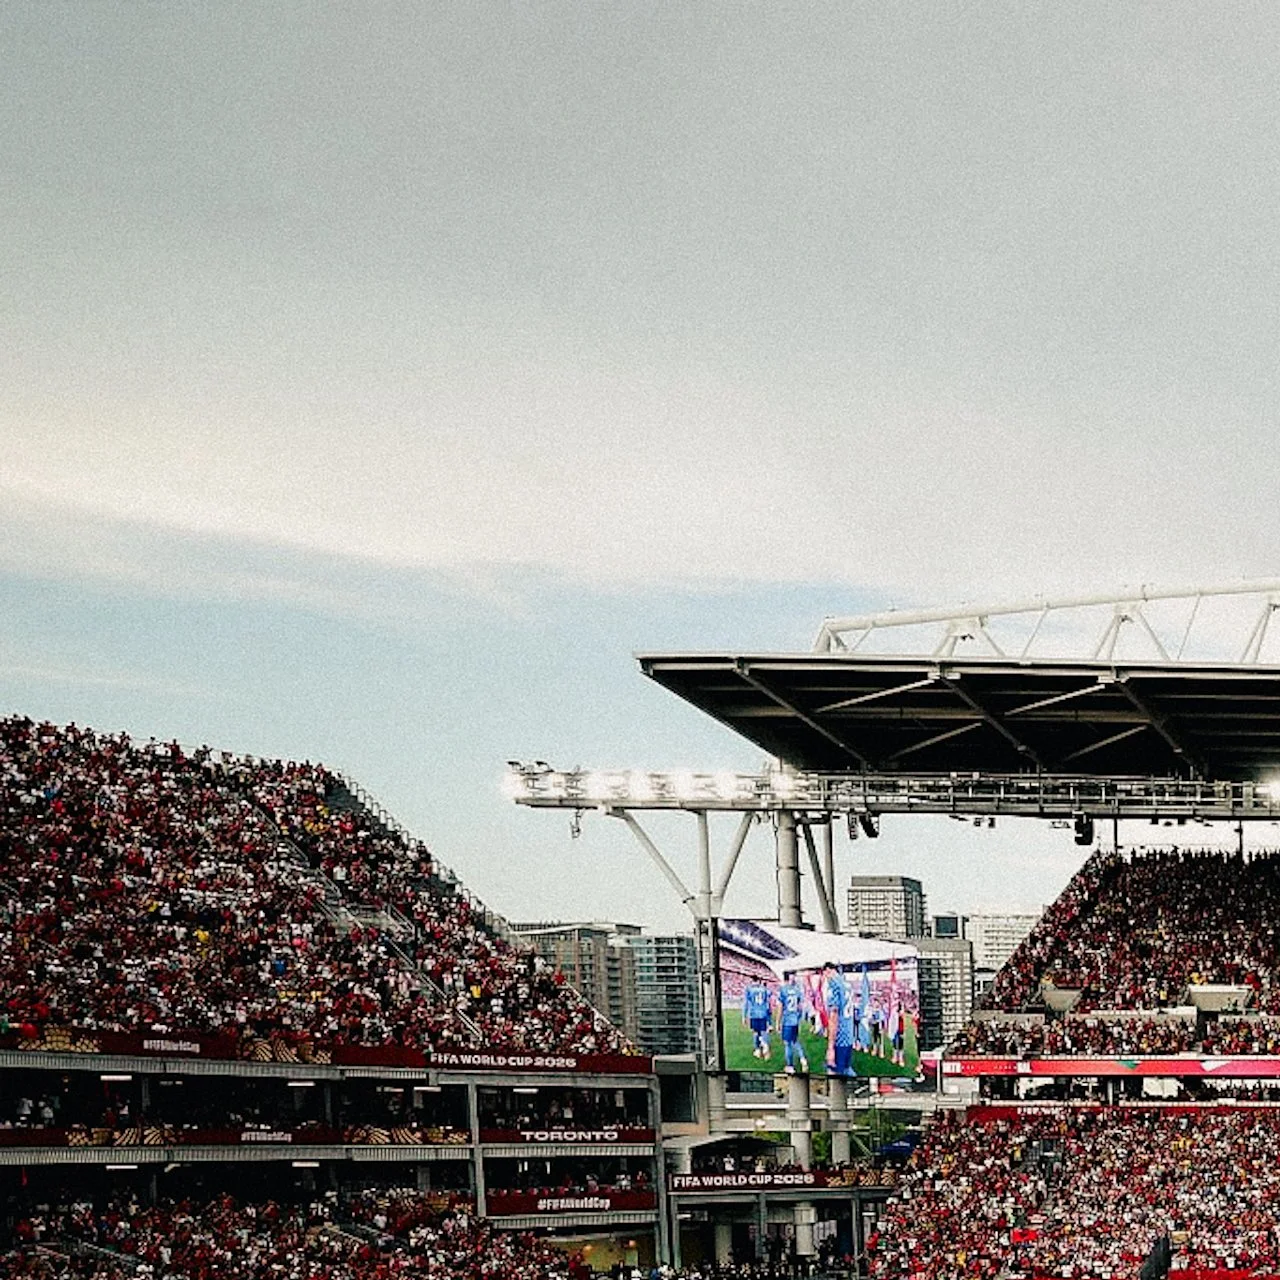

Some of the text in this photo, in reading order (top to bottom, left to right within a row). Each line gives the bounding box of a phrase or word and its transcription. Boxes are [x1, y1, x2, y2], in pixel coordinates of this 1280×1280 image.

[430, 1053, 577, 1068] FIFA WORLD CUP 2026
[520, 1131, 619, 1142] TORONTO
[673, 1174, 816, 1188] FIFA WORLD CUP 2026
